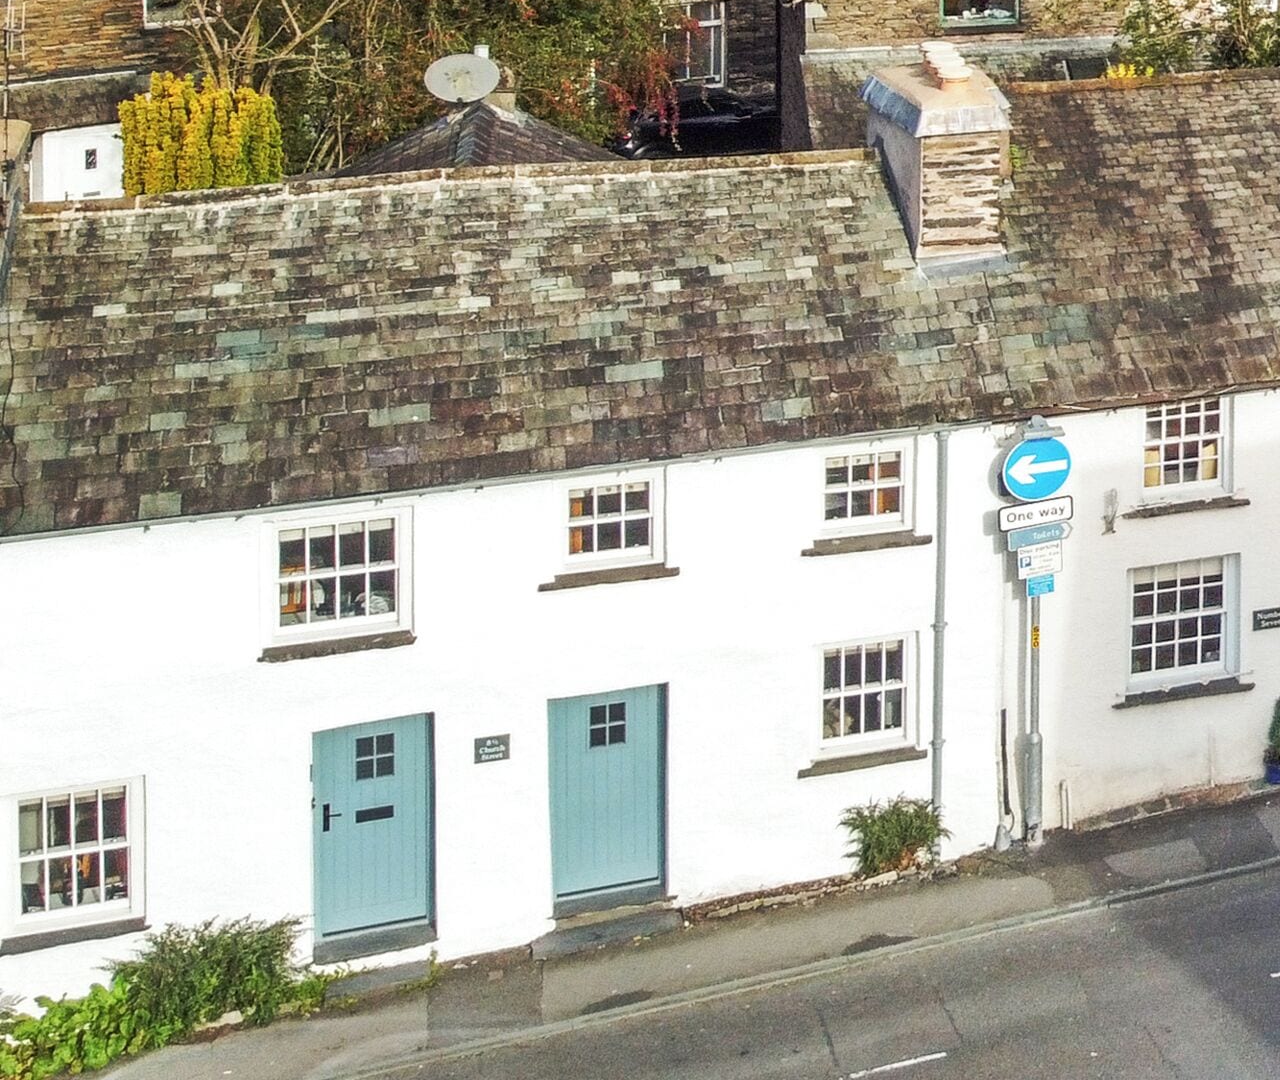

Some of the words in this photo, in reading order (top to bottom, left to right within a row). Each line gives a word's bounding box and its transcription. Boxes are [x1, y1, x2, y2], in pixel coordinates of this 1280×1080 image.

[1006, 512, 1033, 523] One
[1039, 506, 1065, 517] way
[1033, 529, 1060, 540] Toilets
[1022, 557, 1030, 568] P
[479, 744, 506, 754] Church
[481, 752, 503, 761] Street
